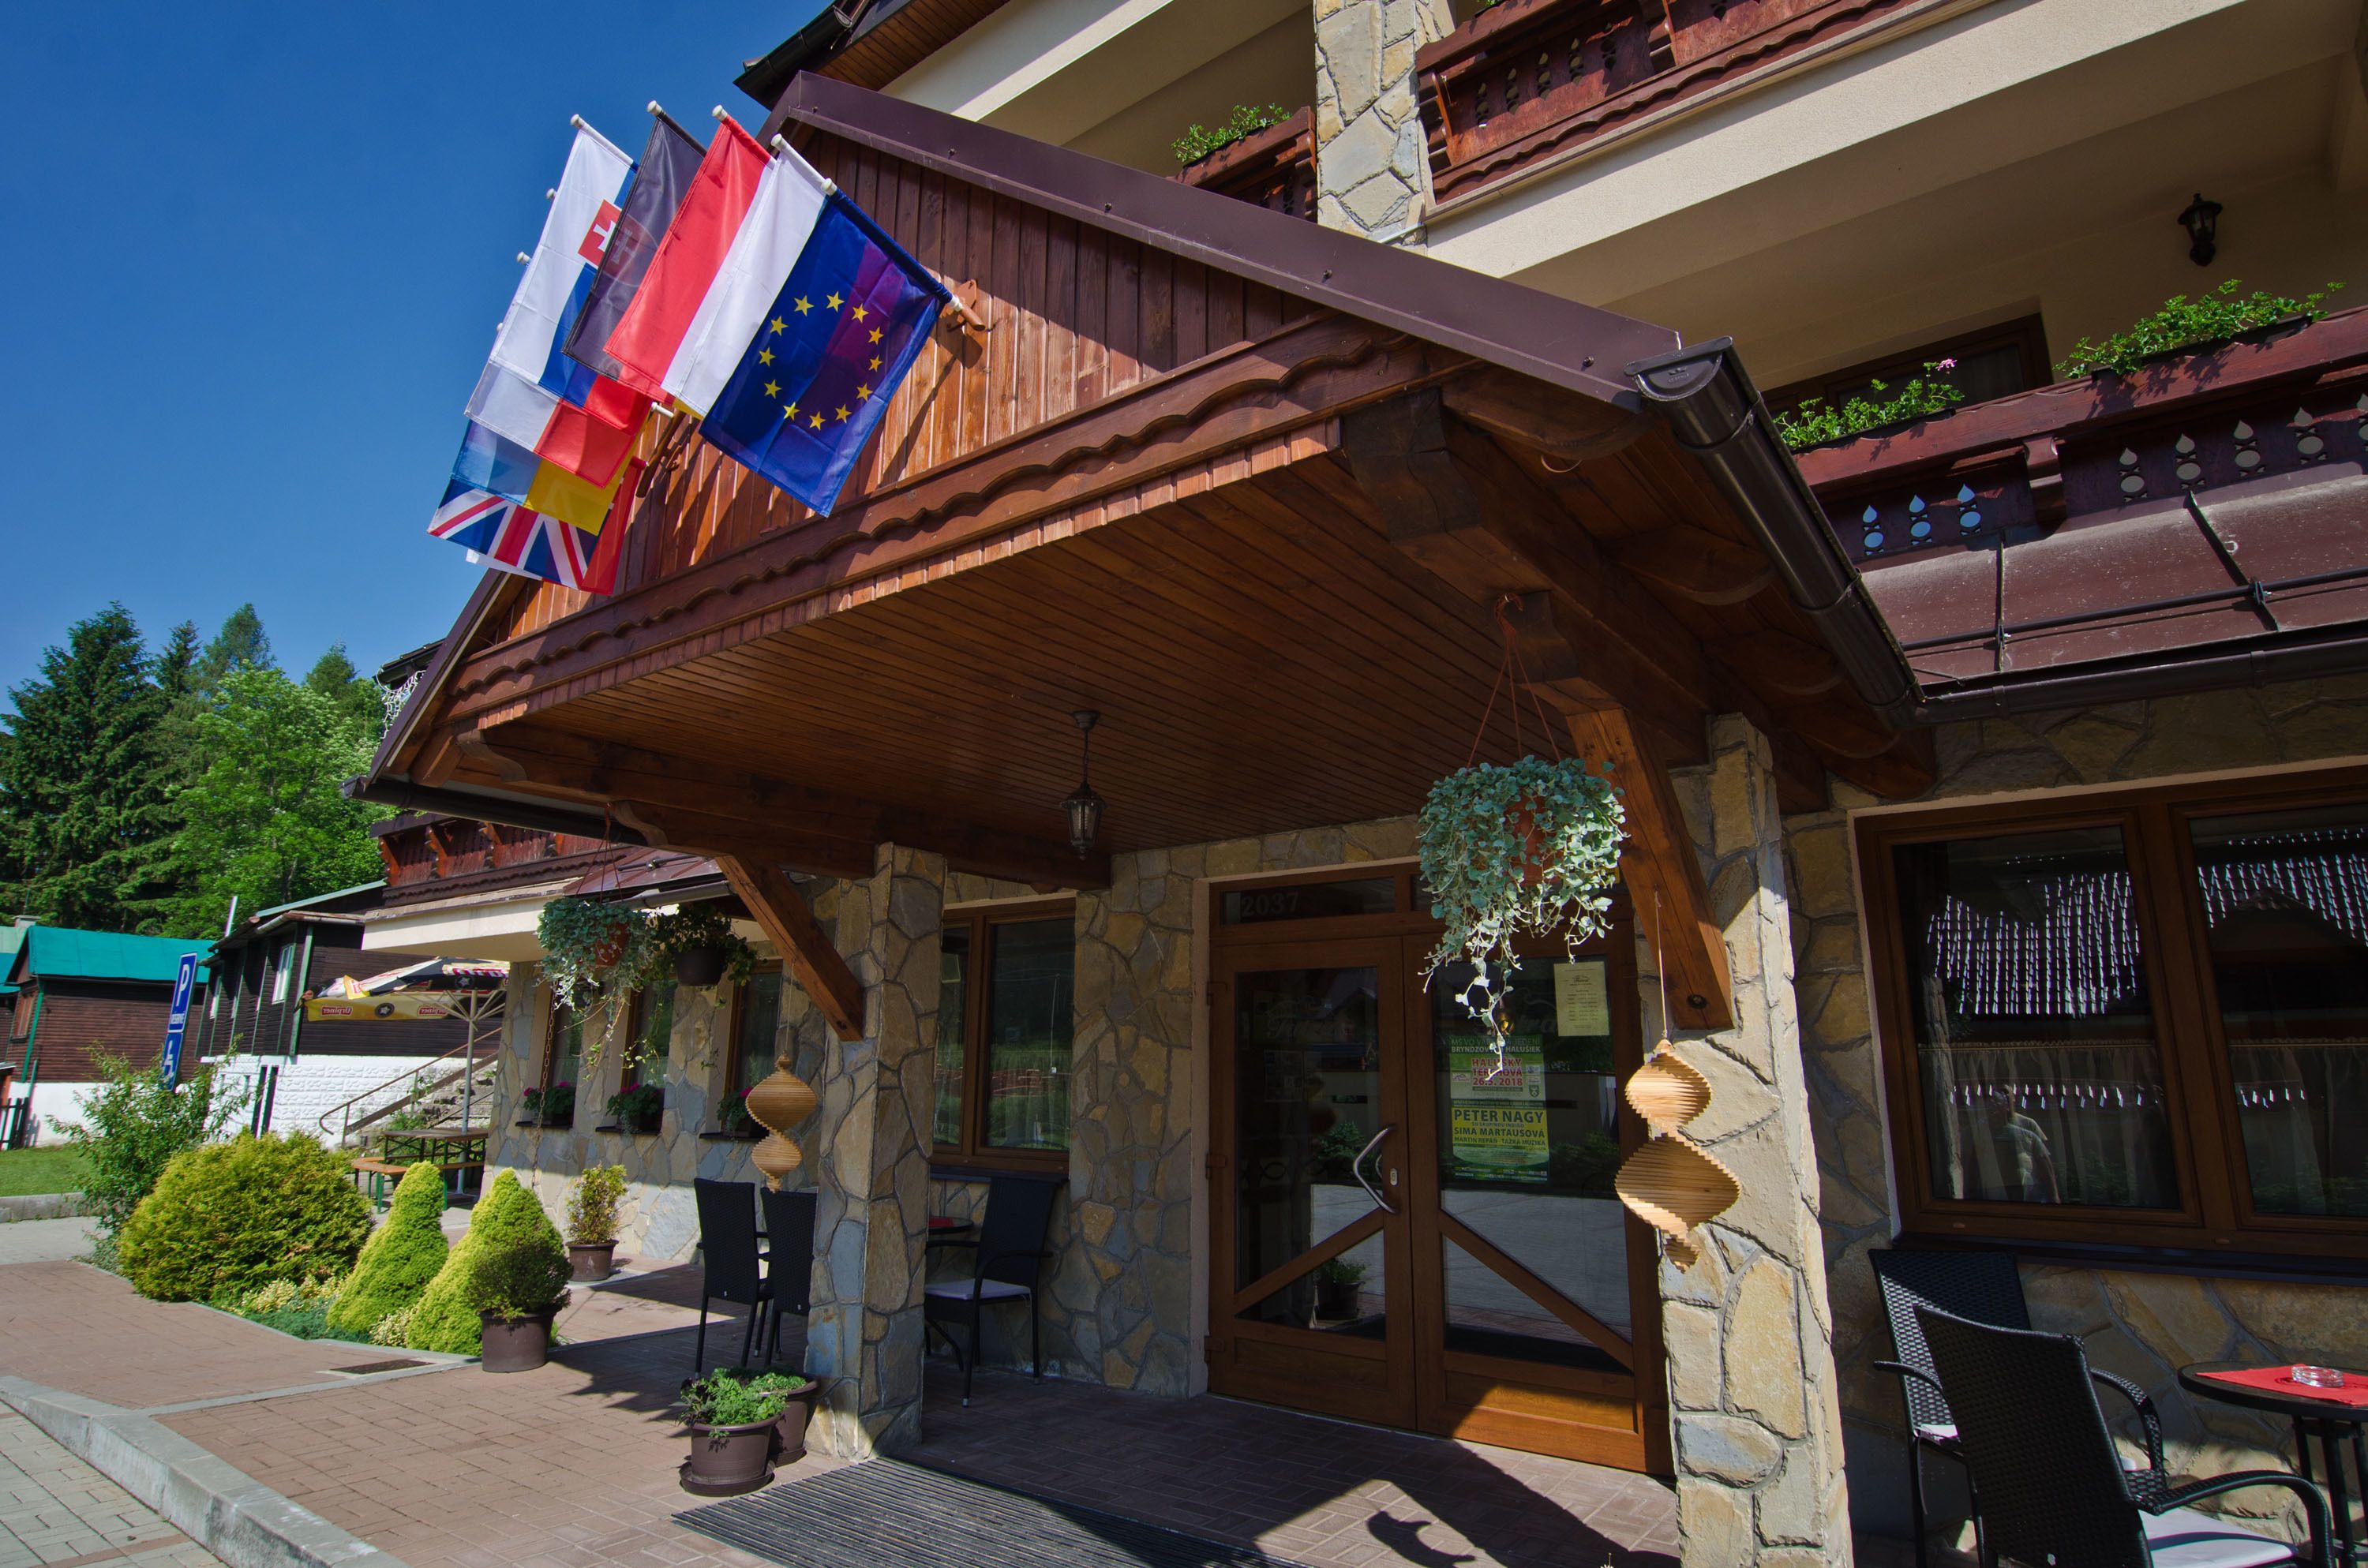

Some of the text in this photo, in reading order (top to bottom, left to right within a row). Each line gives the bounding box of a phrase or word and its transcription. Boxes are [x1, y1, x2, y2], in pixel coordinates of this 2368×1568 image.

[1242, 890, 1299, 917] 2037
[175, 964, 189, 1007] P
[1499, 1078, 1523, 1087] 2018
[1454, 1109, 1544, 1124] PETER NAGY
[1454, 1127, 1546, 1138] SIMA MARTAUSOVÁ
